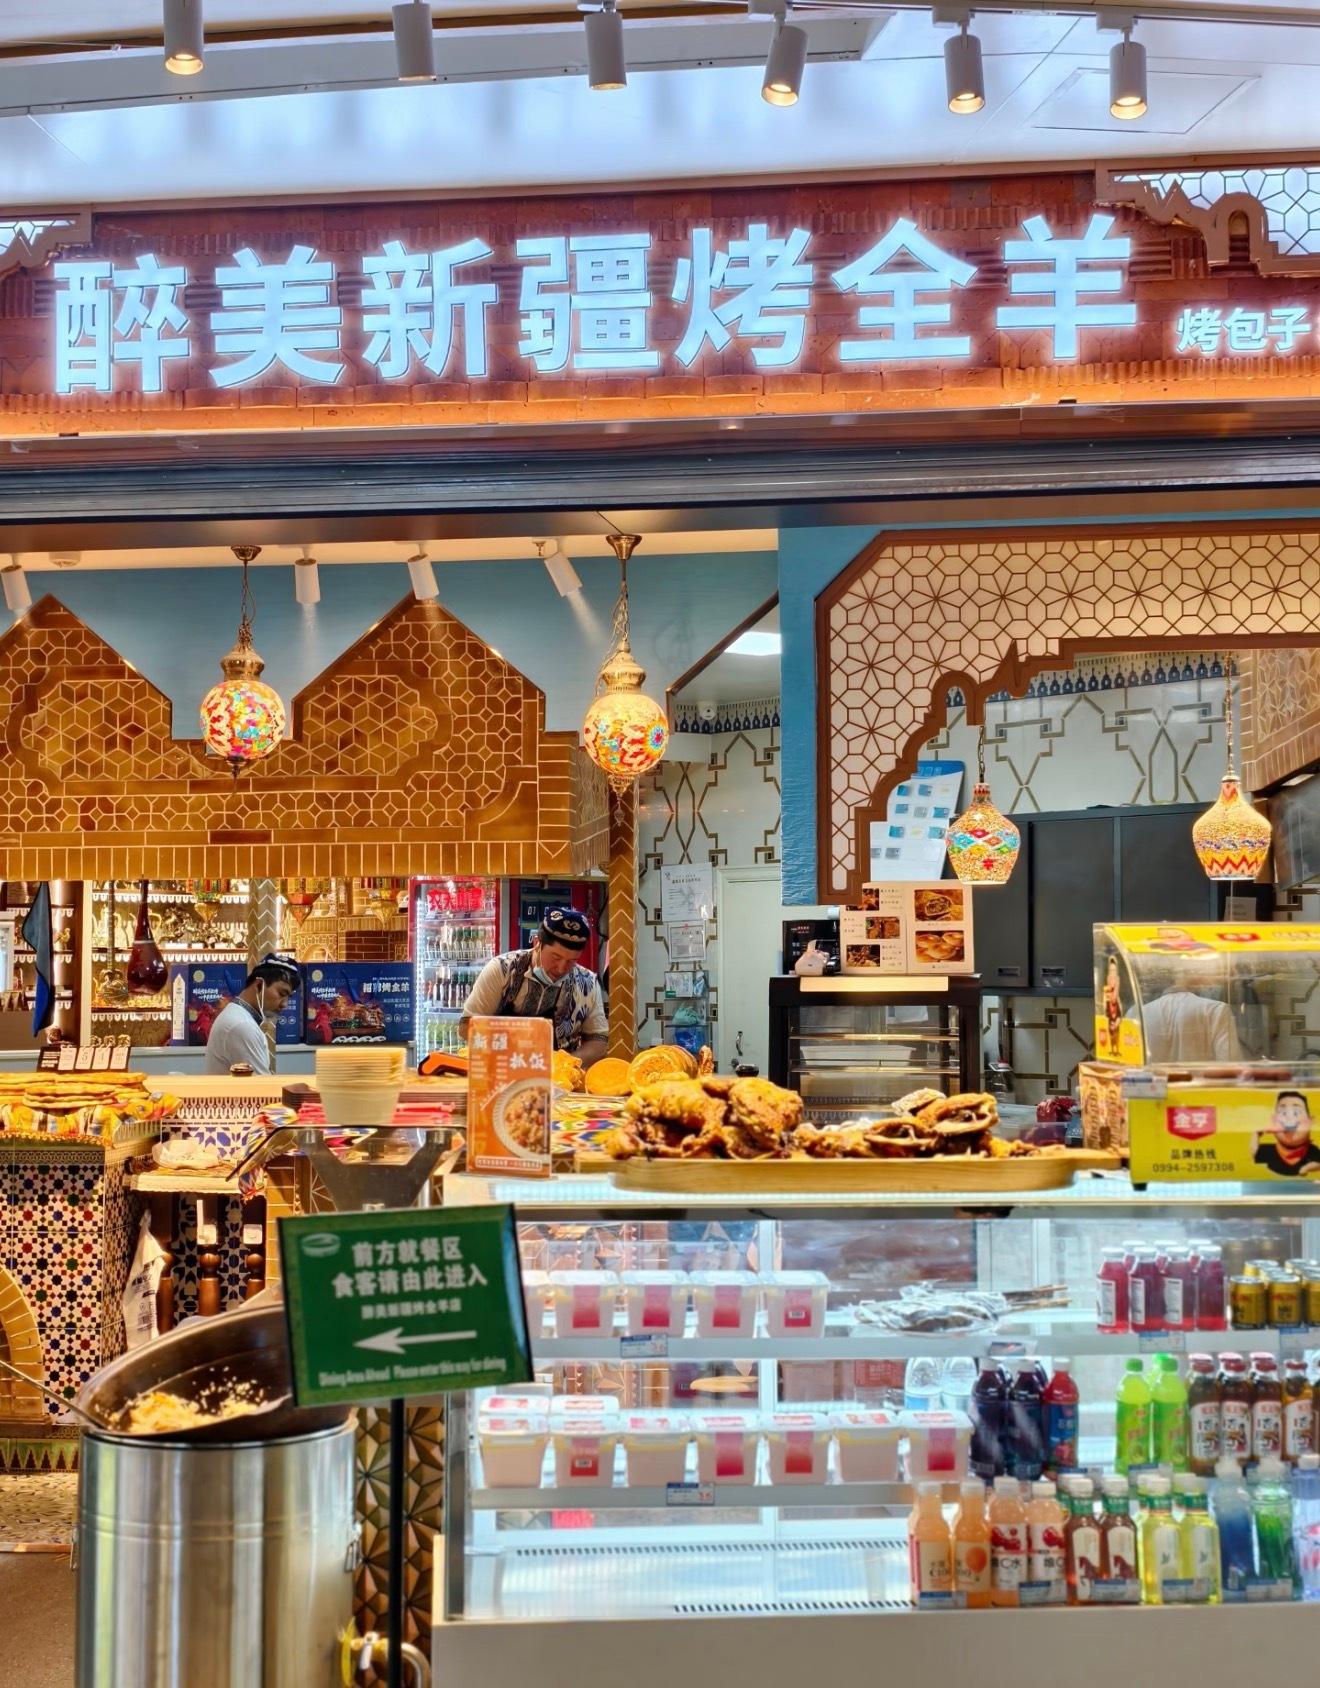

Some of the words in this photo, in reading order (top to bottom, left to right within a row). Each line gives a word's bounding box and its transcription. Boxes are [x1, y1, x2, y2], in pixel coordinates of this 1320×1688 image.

[53, 214, 1138, 395] 醉美新疆烤全羊
[1176, 307, 1312, 353] 烤包子
[472, 1032, 508, 1051] 新疆
[1170, 1149, 1217, 1160] 品牌热线
[352, 1236, 463, 1268] 前方就餐区
[332, 1263, 488, 1299] 食客请由此进入
